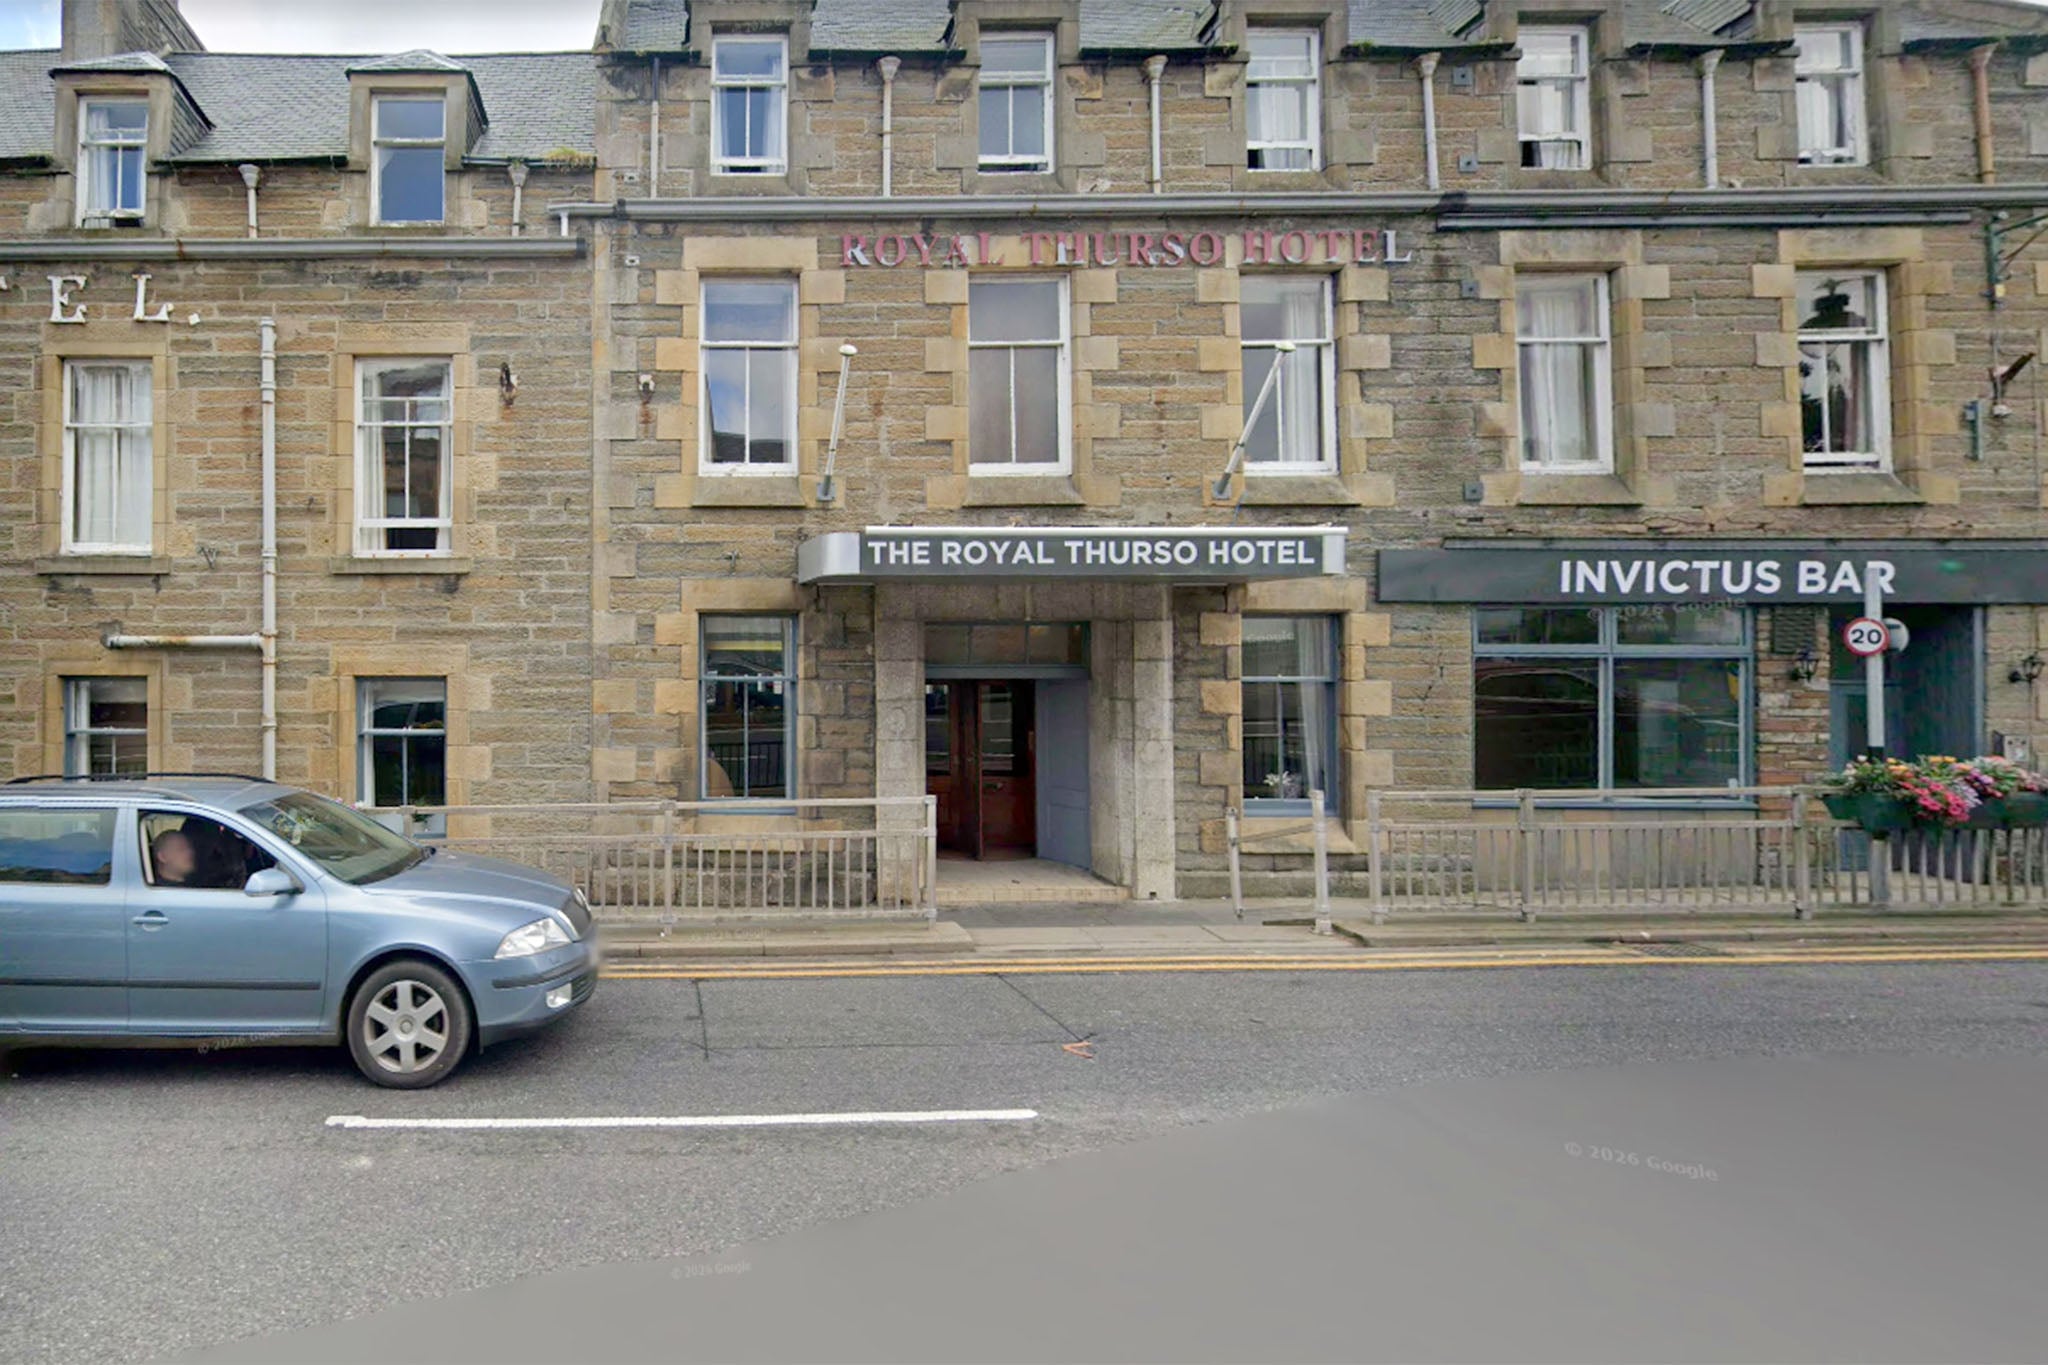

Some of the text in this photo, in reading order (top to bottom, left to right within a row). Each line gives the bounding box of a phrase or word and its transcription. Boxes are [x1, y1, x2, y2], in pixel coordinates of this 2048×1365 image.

[840, 229, 1413, 267] ROYAL THURSO HOTEL
[0, 273, 200, 326] EL.
[867, 540, 1316, 565] THE ROYAL THURSO HOTEL
[1560, 559, 1782, 595] INVICTUS
[1850, 628, 1882, 645] 20
